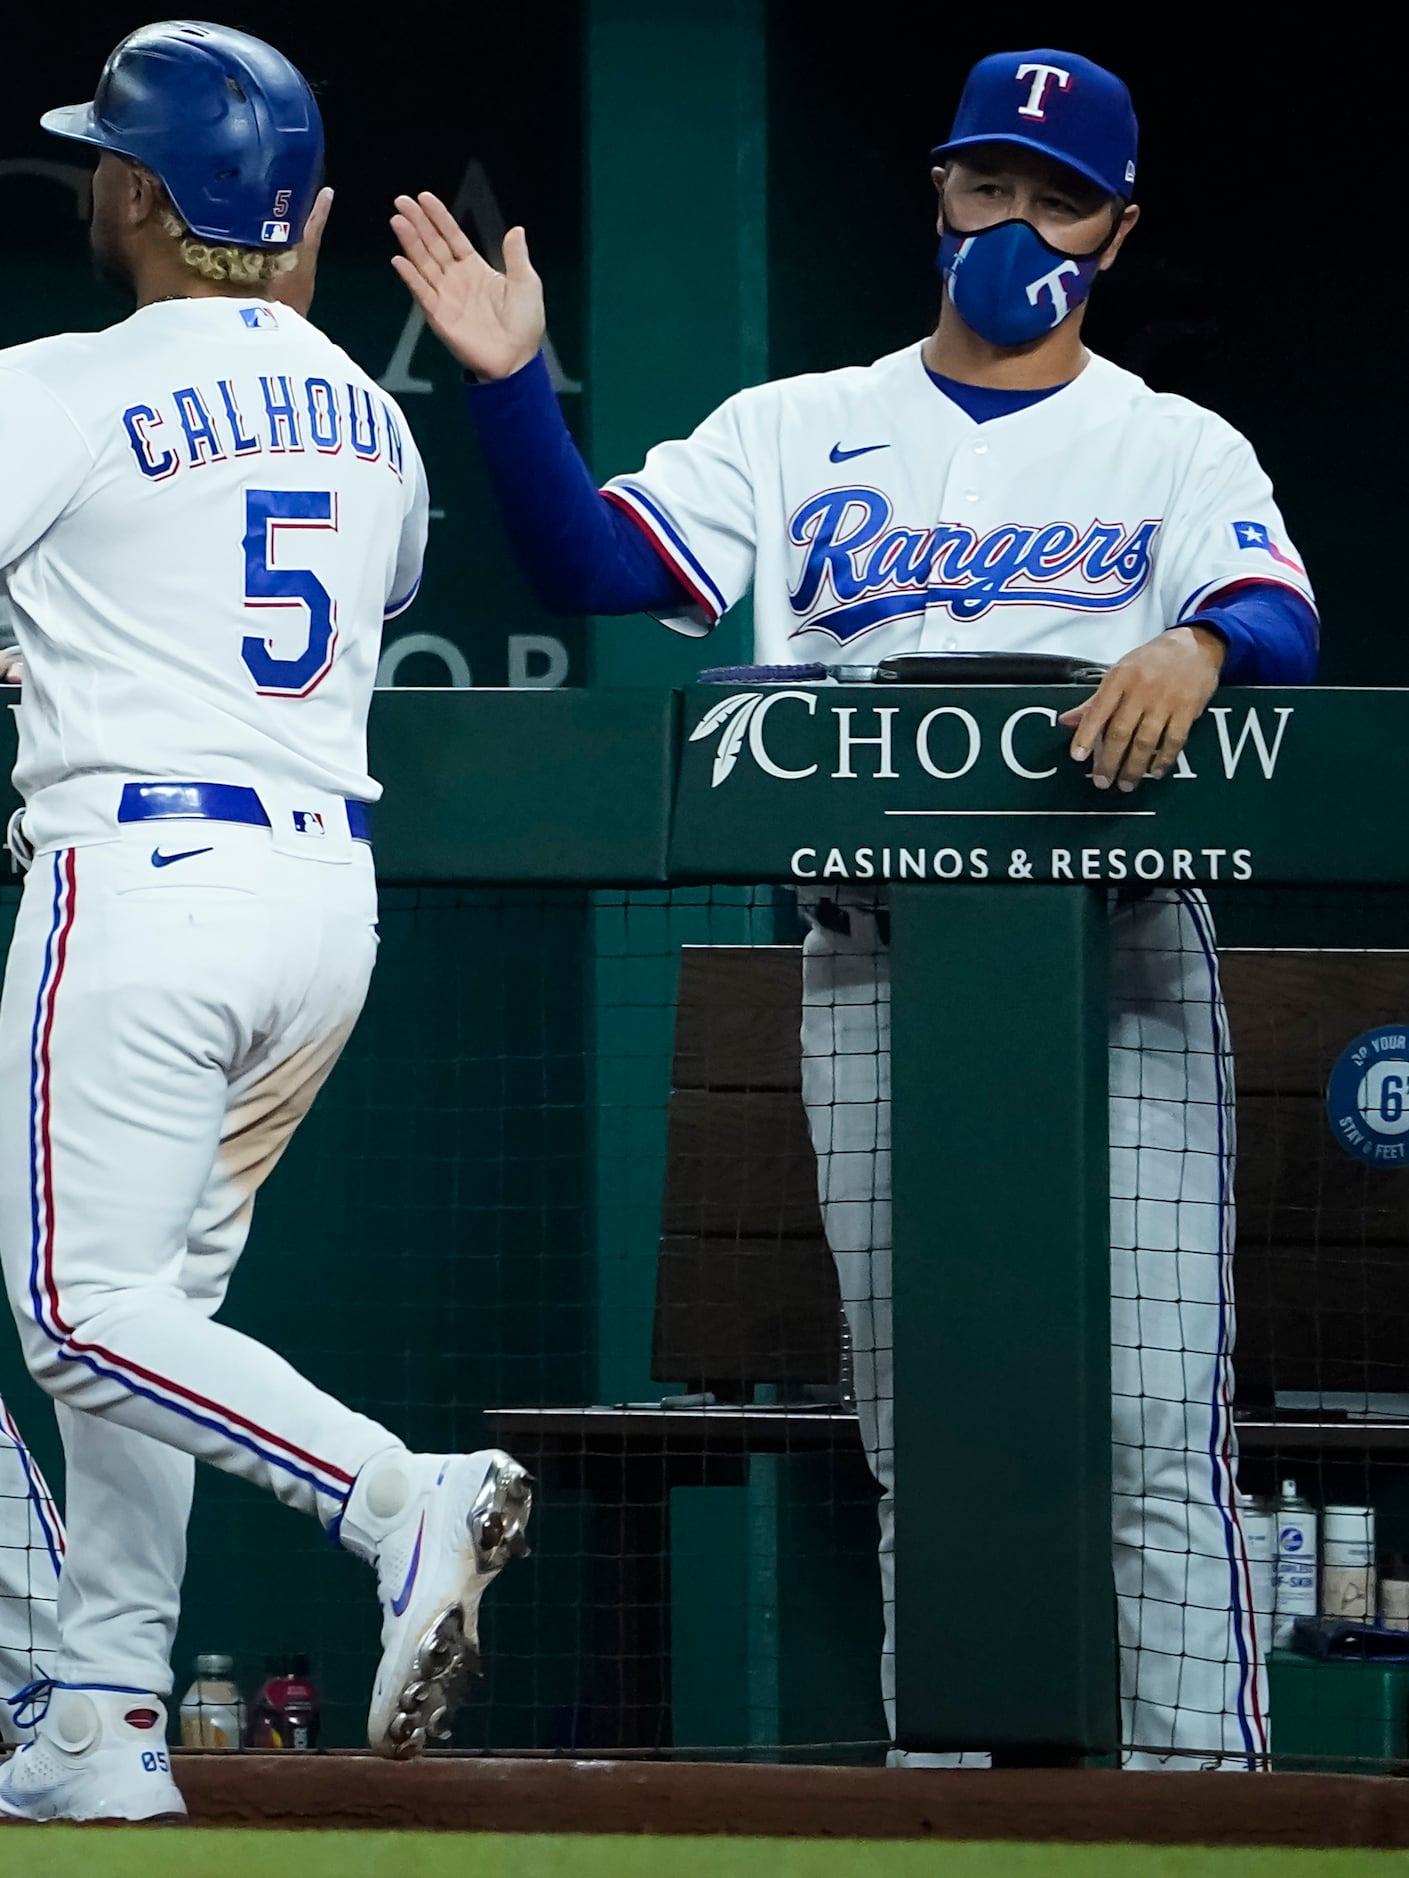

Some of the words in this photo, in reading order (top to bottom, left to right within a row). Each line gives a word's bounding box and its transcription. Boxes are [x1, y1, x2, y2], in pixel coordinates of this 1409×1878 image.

[1016, 63, 1073, 122] T
[273, 190, 292, 217] 5
[1025, 260, 1080, 328] T
[788, 485, 1163, 626] Rangers
[240, 488, 338, 698] 5
[749, 690, 1294, 781] CHOCW
[791, 847, 989, 880] CASINOS
[1007, 847, 1034, 880] &
[1052, 848, 1253, 881] RESORTS
[1371, 1034, 1407, 1054] YOUR
[1380, 1075, 1409, 1122] 6
[1339, 1116, 1365, 1146] STAY
[1374, 1143, 1406, 1161] FEET
[141, 1750, 169, 1772] 05
